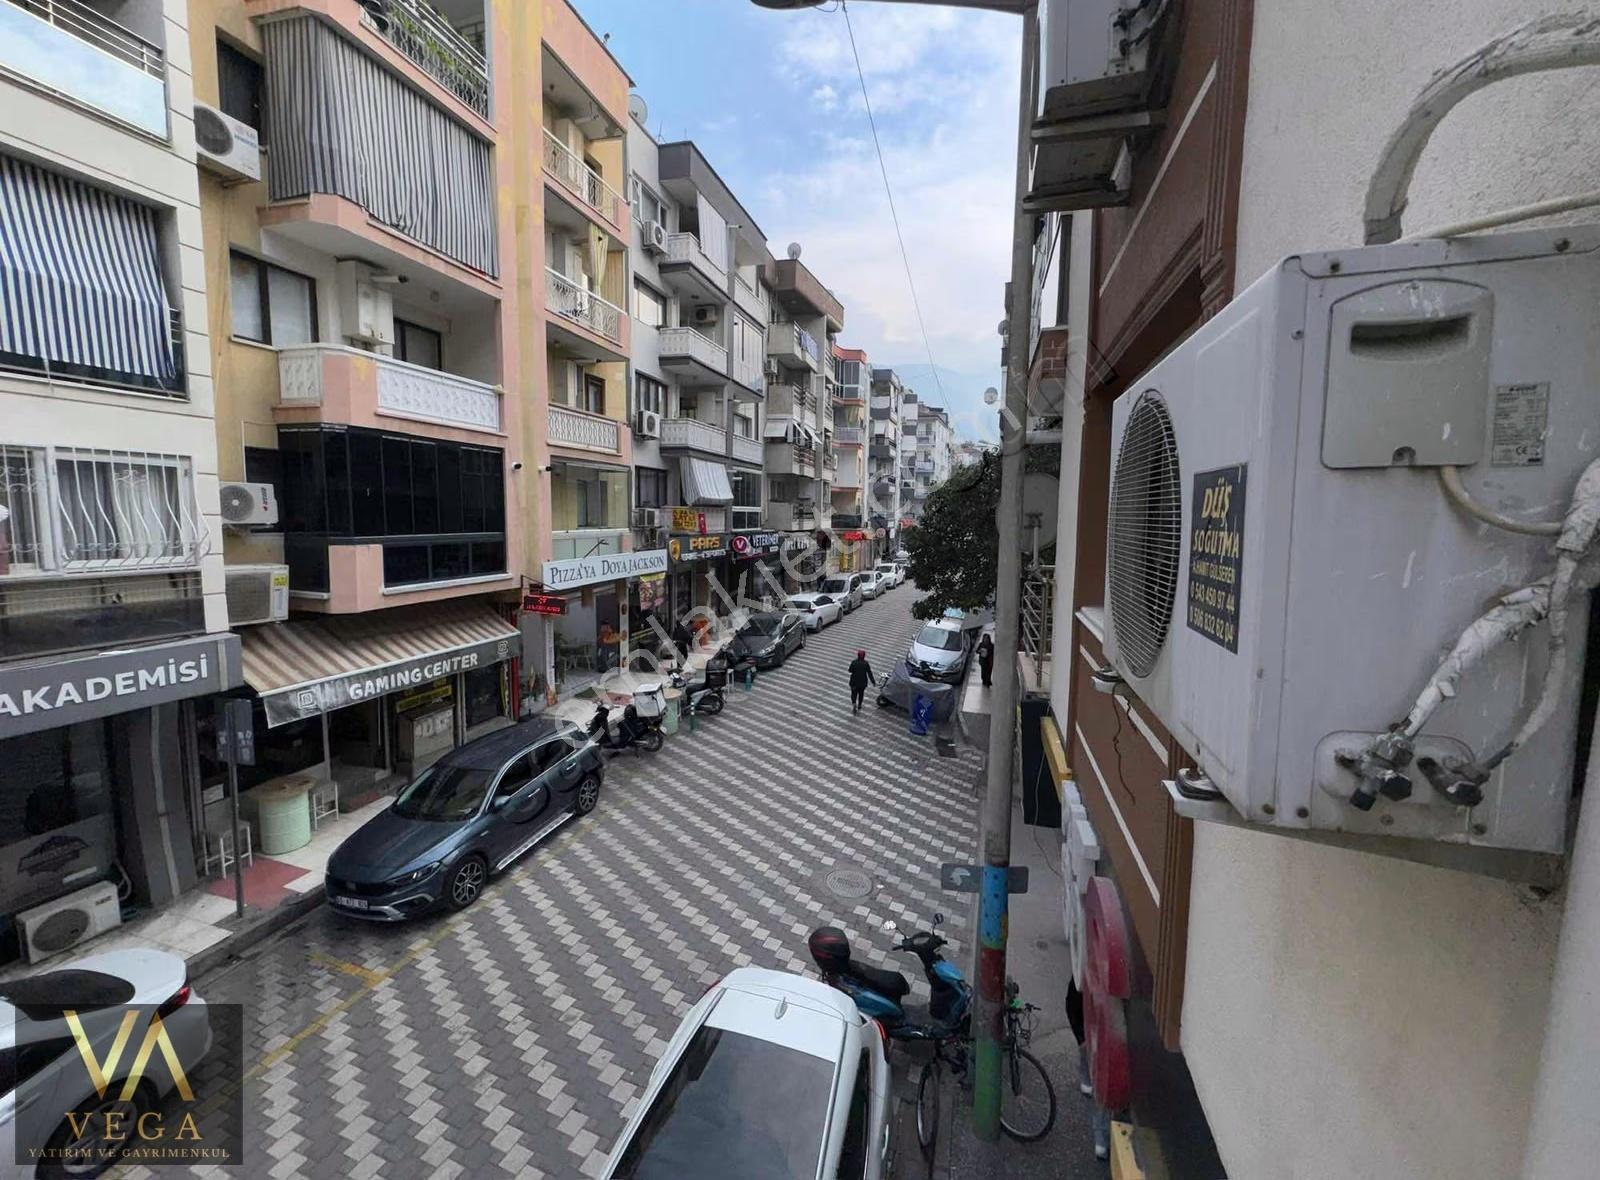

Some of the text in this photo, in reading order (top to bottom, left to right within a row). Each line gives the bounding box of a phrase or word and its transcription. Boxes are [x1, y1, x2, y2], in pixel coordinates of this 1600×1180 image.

[1202, 476, 1232, 527] DÜŞ
[689, 536, 721, 551] PARS
[550, 562, 597, 585] PIZZA'YA
[0, 653, 209, 717] AKADEMİSİ
[350, 667, 422, 700] GAMING
[424, 653, 479, 679] CENTER
